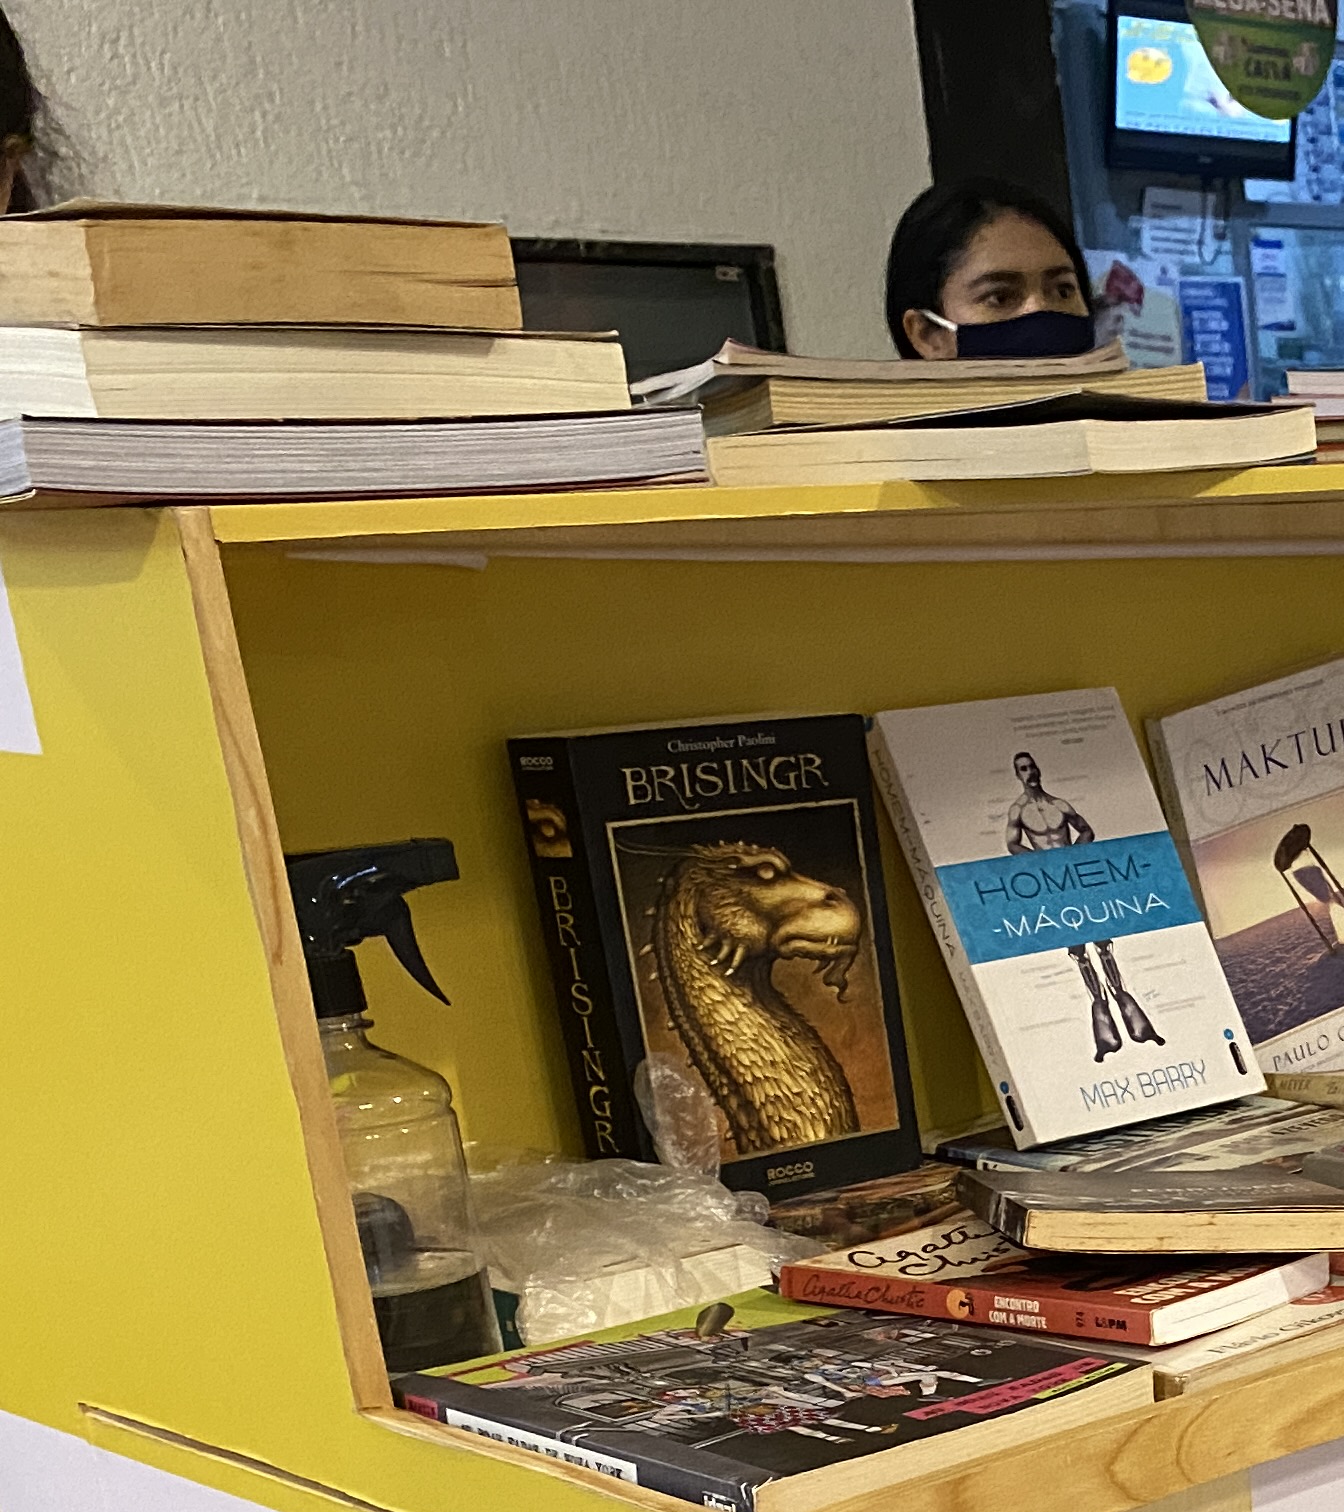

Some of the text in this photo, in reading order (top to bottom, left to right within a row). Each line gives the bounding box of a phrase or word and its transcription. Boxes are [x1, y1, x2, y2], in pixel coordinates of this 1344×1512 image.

[667, 732, 777, 754] Christopher Paolini
[620, 753, 829, 811] BRISINGR
[991, 892, 1171, 940] -MÁQUINA
[550, 876, 619, 1154] BRISINGR
[1270, 1036, 1331, 1074] PAULO
[1080, 1060, 1207, 1113] MAX BARRY
[767, 1161, 815, 1181] ROCCO
[988, 1309, 1049, 1331] COM A MORTE
[993, 1294, 1041, 1314] ENCONTRO
